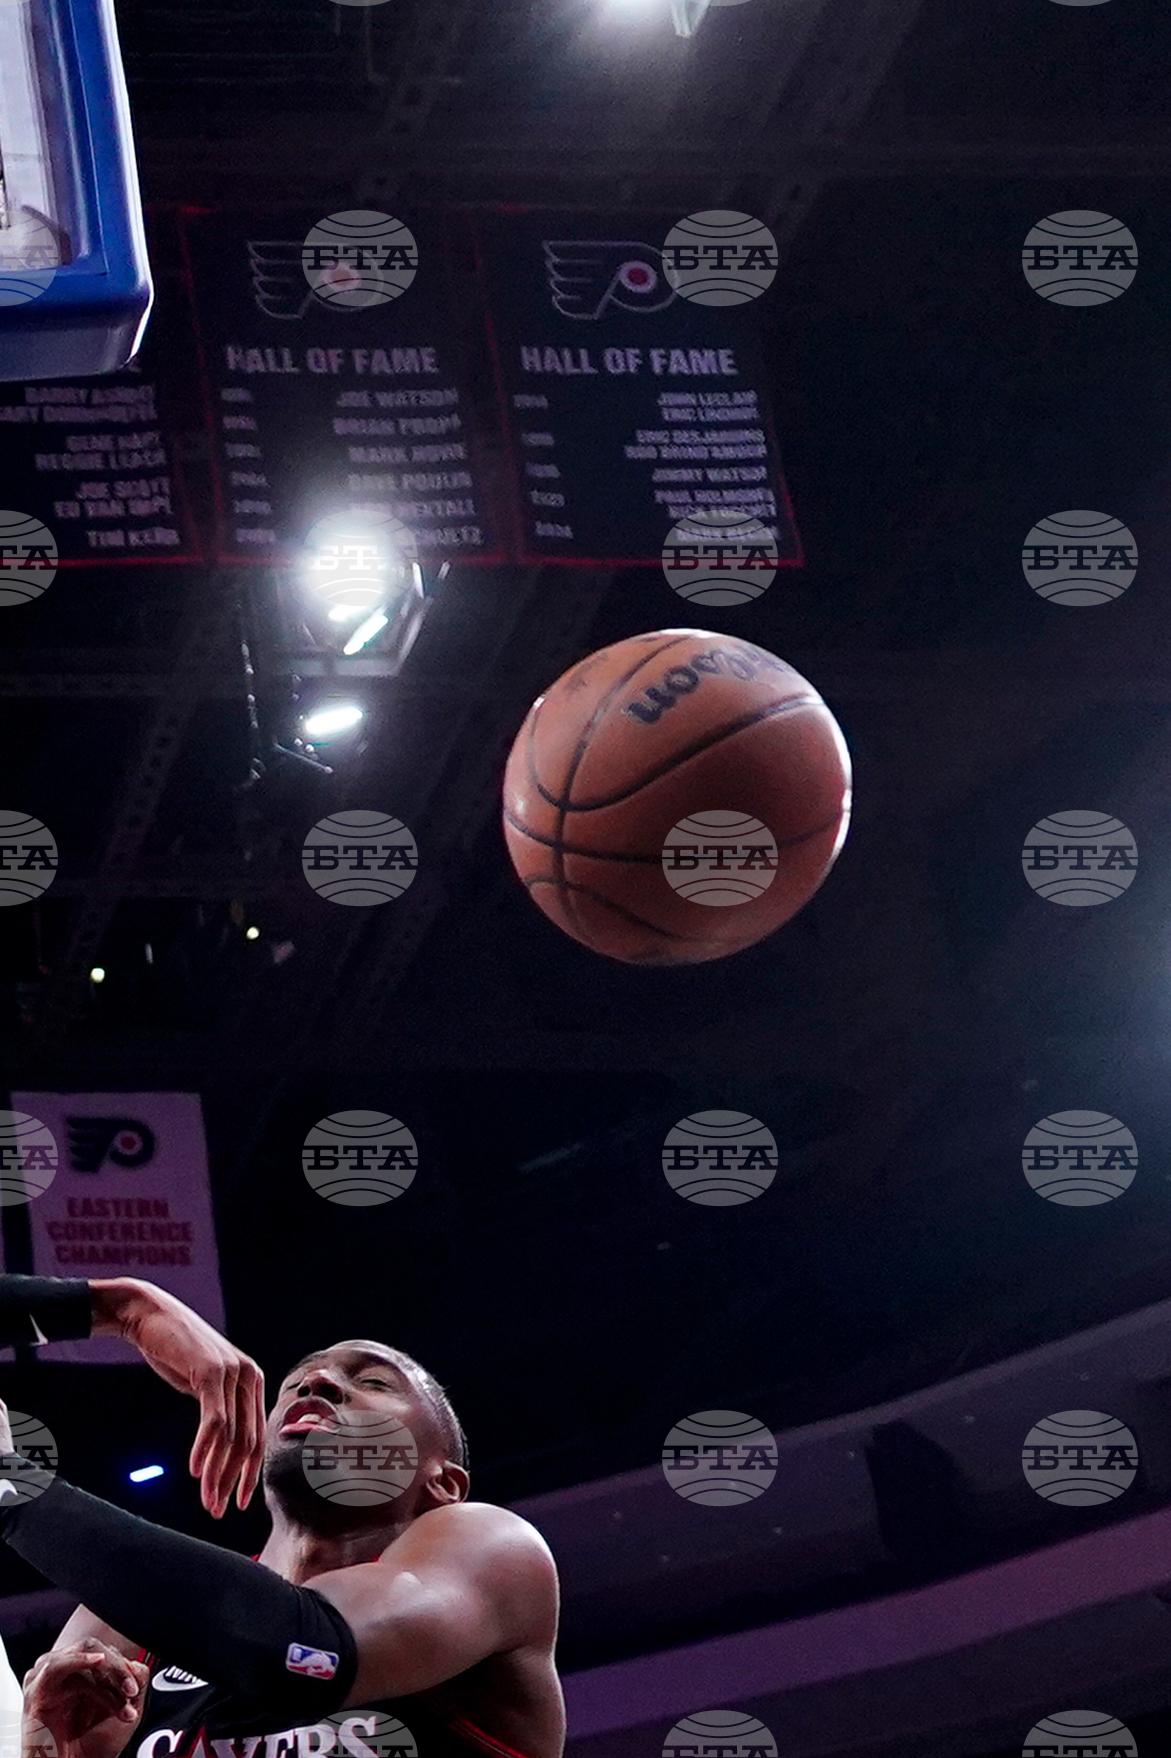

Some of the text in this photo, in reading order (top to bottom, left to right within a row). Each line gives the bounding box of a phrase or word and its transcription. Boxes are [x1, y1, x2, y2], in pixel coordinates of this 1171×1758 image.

[226, 345, 440, 374] HALL OF FAME
[520, 345, 740, 376] HALL OF FAME
[67, 1196, 169, 1218] EASTERN
[46, 1221, 193, 1242] CONFERENCE
[55, 1244, 193, 1266] CHAMPIONS
